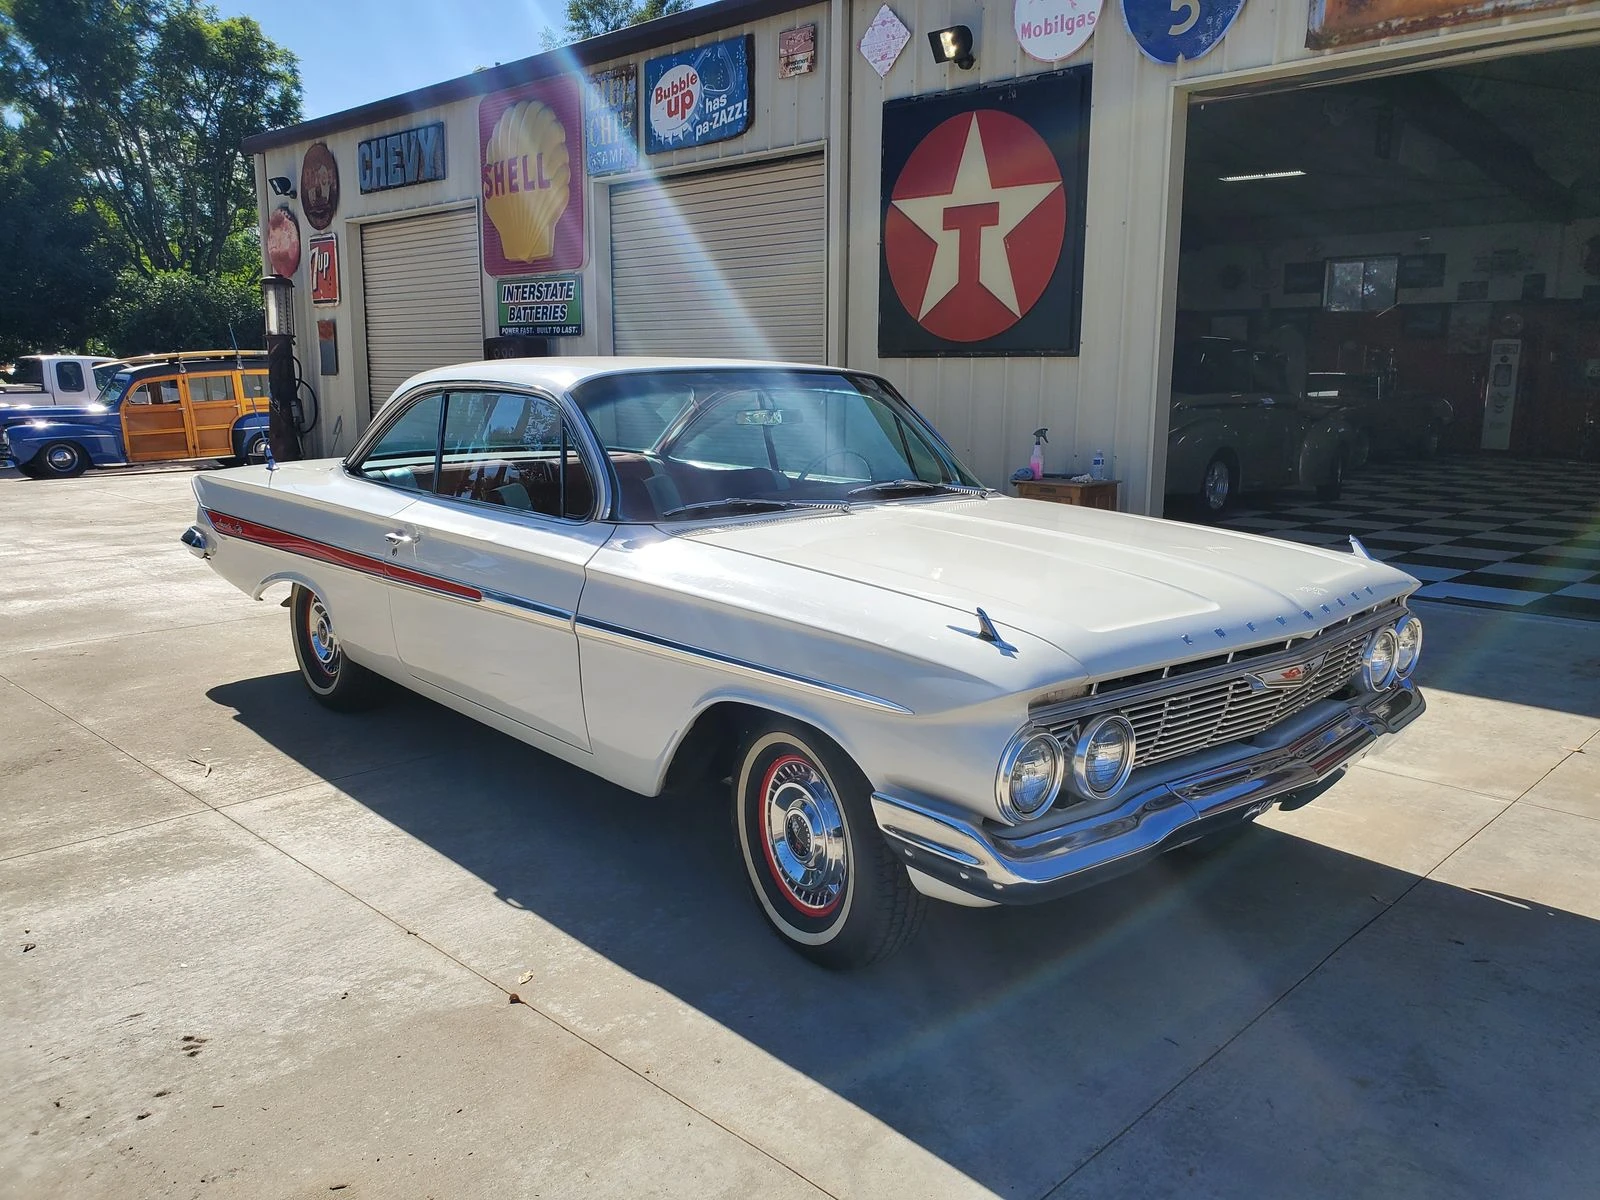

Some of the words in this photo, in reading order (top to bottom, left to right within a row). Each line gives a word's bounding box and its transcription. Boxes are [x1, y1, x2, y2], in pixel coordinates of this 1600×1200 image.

[1021, 10, 1096, 40] Mobilgas
[1168, 0, 1200, 36] 5
[655, 72, 697, 105] Bubble
[705, 94, 727, 114] has
[666, 89, 694, 120] up
[695, 99, 748, 141] pa-ZAZZ!
[358, 126, 439, 190] CHEVY
[481, 152, 552, 199] SHELL
[502, 280, 575, 303] INTERSTATE
[508, 304, 568, 323] BATTERIES
[501, 327, 519, 335] POWER
[520, 327, 535, 335] FAST.
[537, 326, 551, 334] BUILT
[553, 326, 561, 334] TO
[561, 326, 578, 334] LAST.
